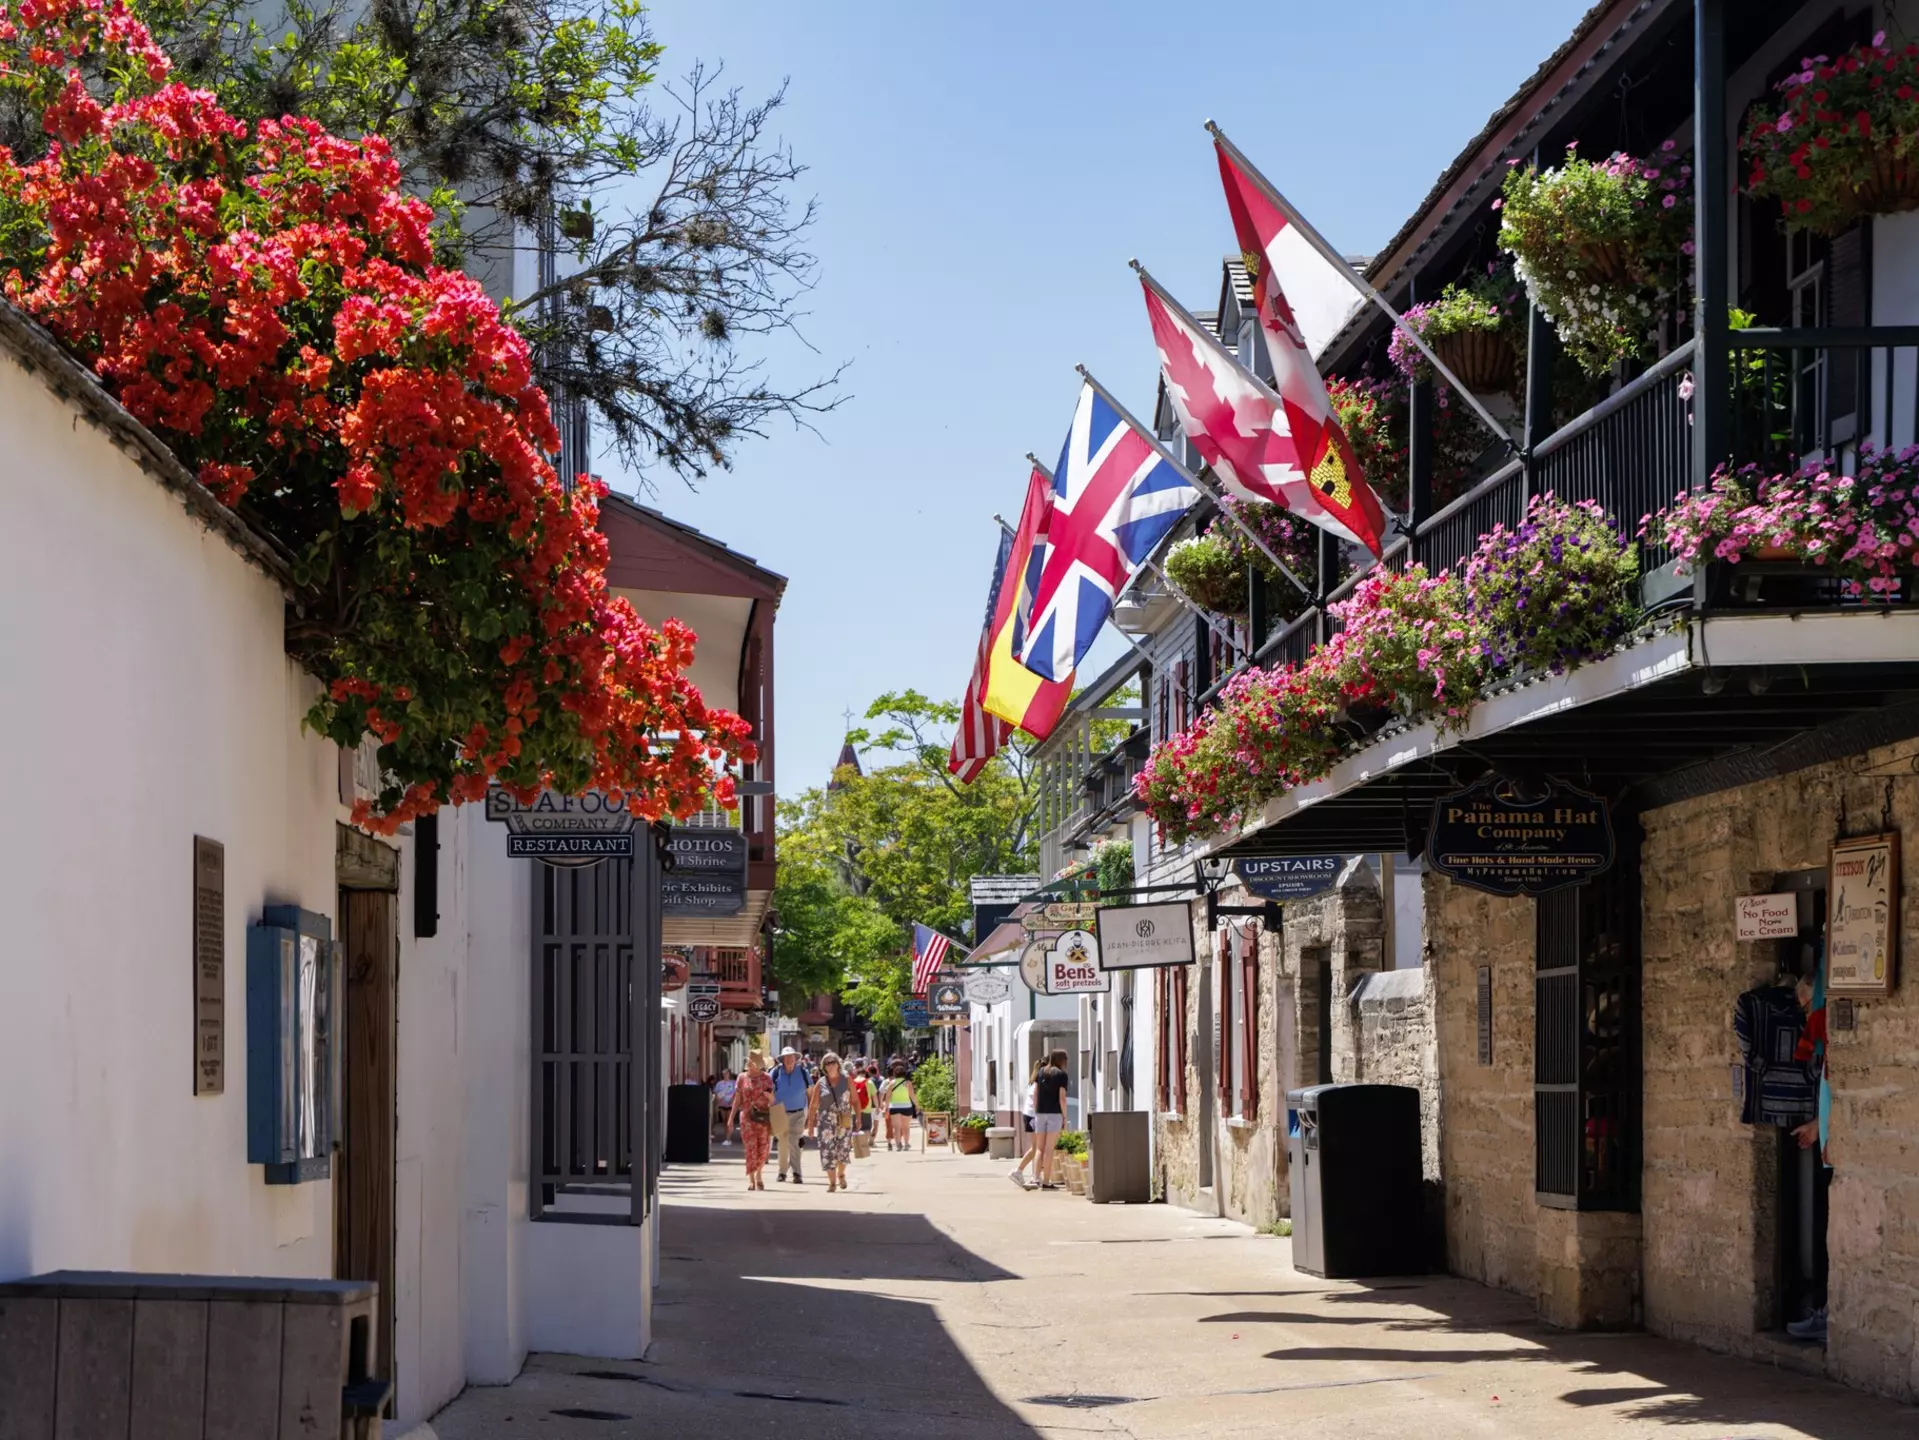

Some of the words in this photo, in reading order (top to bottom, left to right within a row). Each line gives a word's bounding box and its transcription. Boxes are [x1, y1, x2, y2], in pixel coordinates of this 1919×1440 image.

[494, 791, 633, 814] SEAFOO
[1470, 801, 1492, 811] The
[1447, 807, 1545, 824] Panama
[1554, 807, 1598, 824] Hat
[532, 818, 609, 830] COMPANY
[1477, 825, 1567, 841] Company
[513, 839, 629, 851] RESTAURANT
[688, 855, 727, 866] Shrine
[1245, 858, 1335, 874] UPSTAIRS
[1448, 856, 1469, 865] Fine
[1471, 856, 1494, 865] Hats
[1497, 856, 1505, 865] &
[1508, 856, 1535, 865] Hand
[1537, 856, 1565, 865] Made
[1567, 856, 1596, 865] Items
[681, 883, 732, 893] Exhibits
[685, 895, 716, 907] Shop
[1743, 910, 1758, 919] No
[1762, 908, 1789, 917] Food
[1758, 927, 1794, 935] Cream
[1055, 979, 1070, 987] soft
[1072, 979, 1102, 988] pretzels
[690, 1003, 717, 1011] LEGACY
